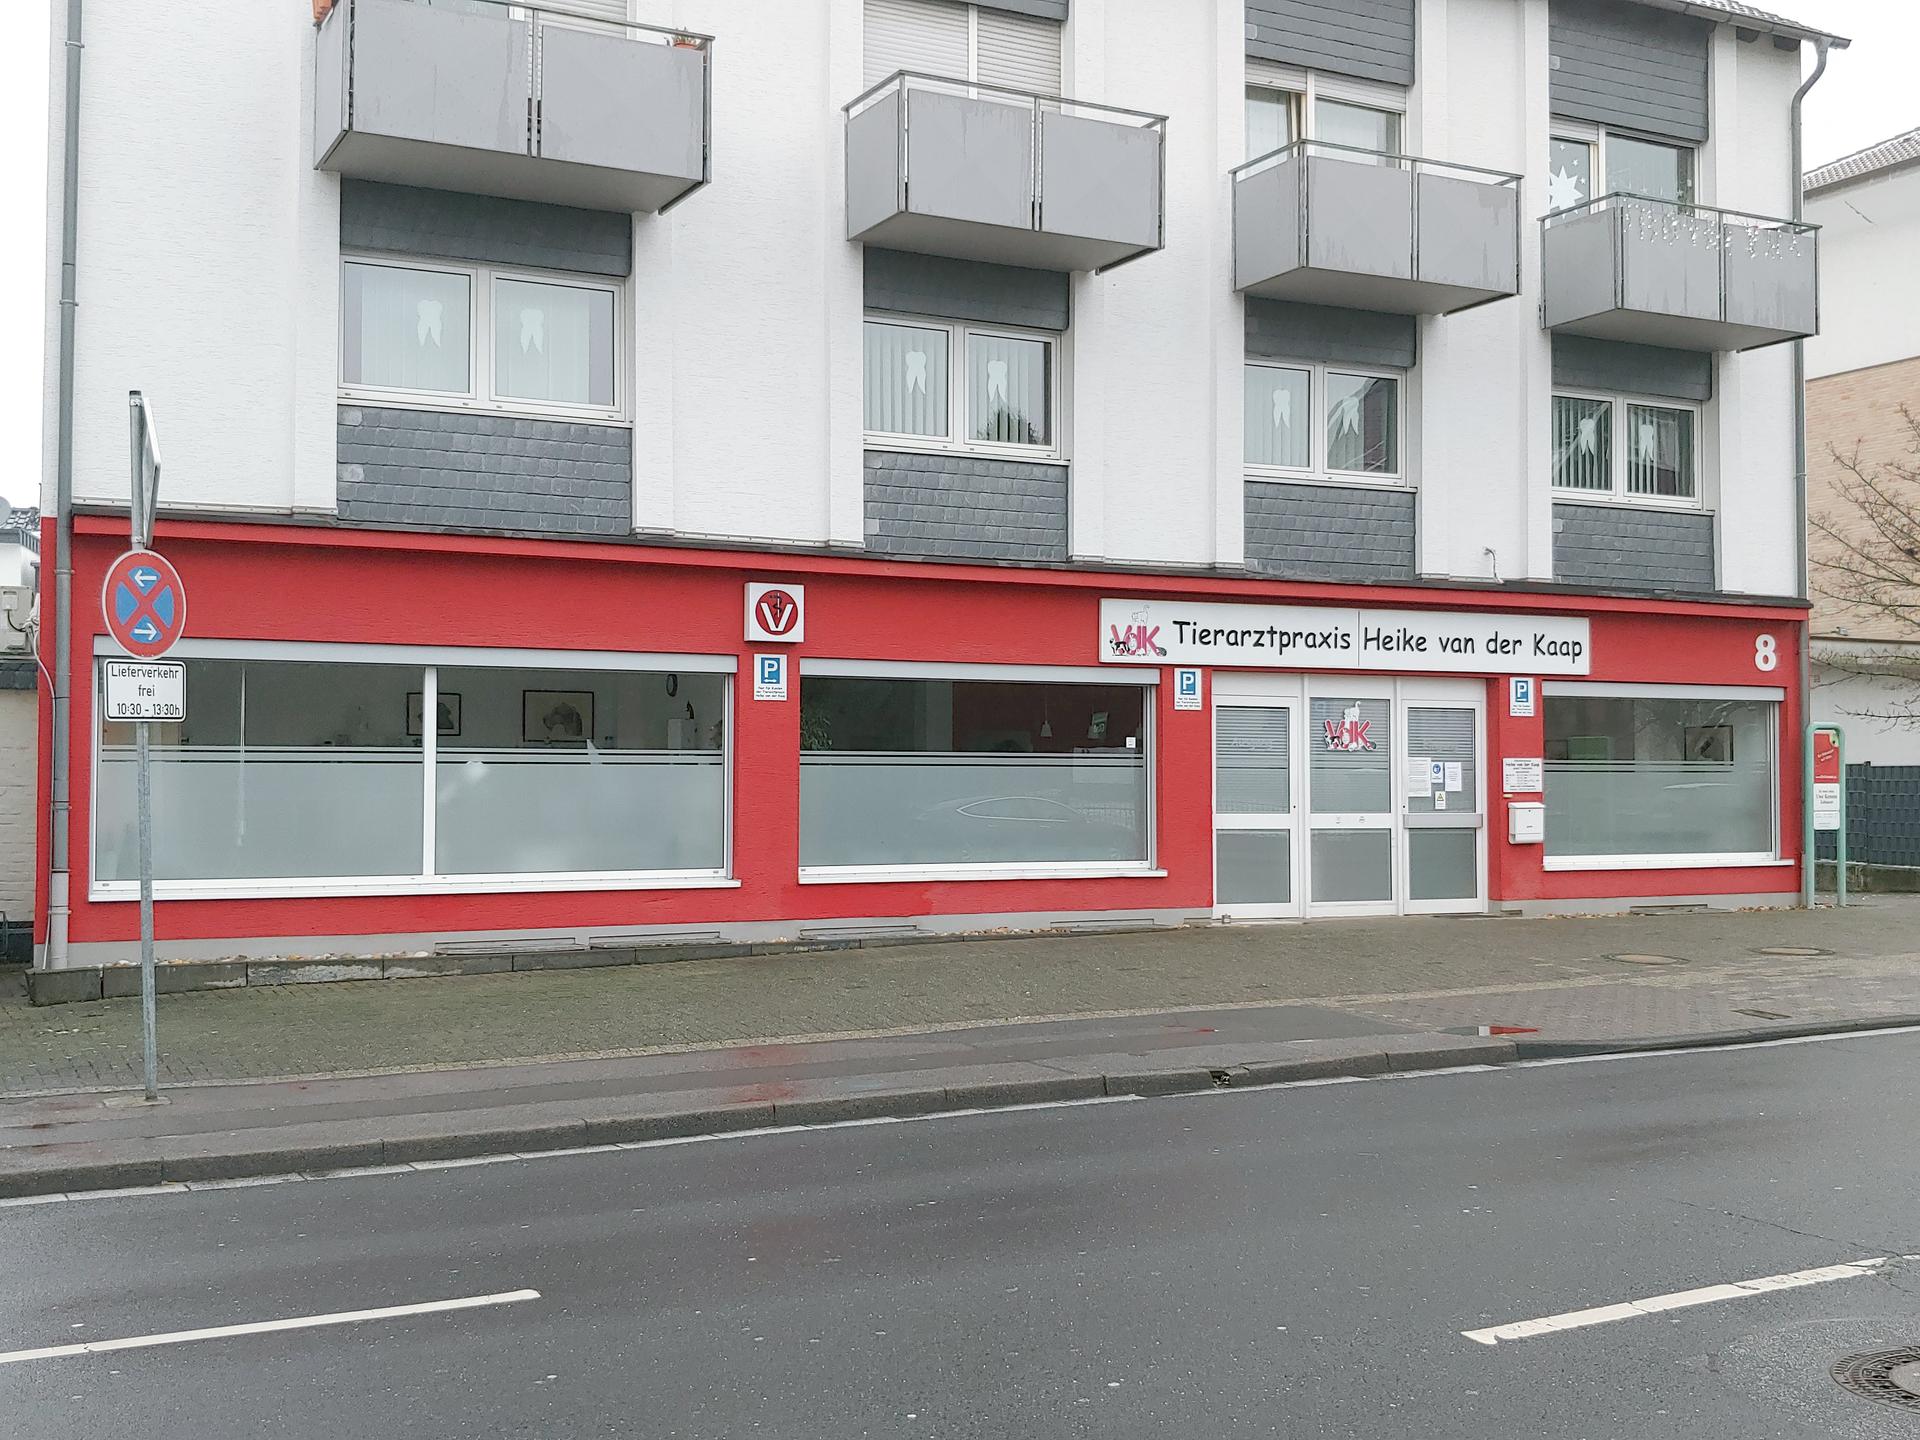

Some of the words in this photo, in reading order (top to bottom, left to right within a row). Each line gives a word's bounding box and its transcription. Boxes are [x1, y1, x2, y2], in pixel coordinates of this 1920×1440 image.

[1172, 620, 1351, 656] Tierarztpraxis
[1363, 626, 1428, 653] Heike
[1438, 636, 1476, 655] van
[1486, 630, 1522, 656] der
[1533, 632, 1583, 665] Kaap
[1754, 633, 1777, 672] 8
[111, 664, 179, 679] Lieferverkehr
[764, 660, 778, 678] P
[1182, 673, 1194, 690] P
[138, 684, 155, 697] frei
[1517, 682, 1527, 698] P
[117, 703, 142, 715] 10:30
[152, 703, 180, 715] 13:30h
